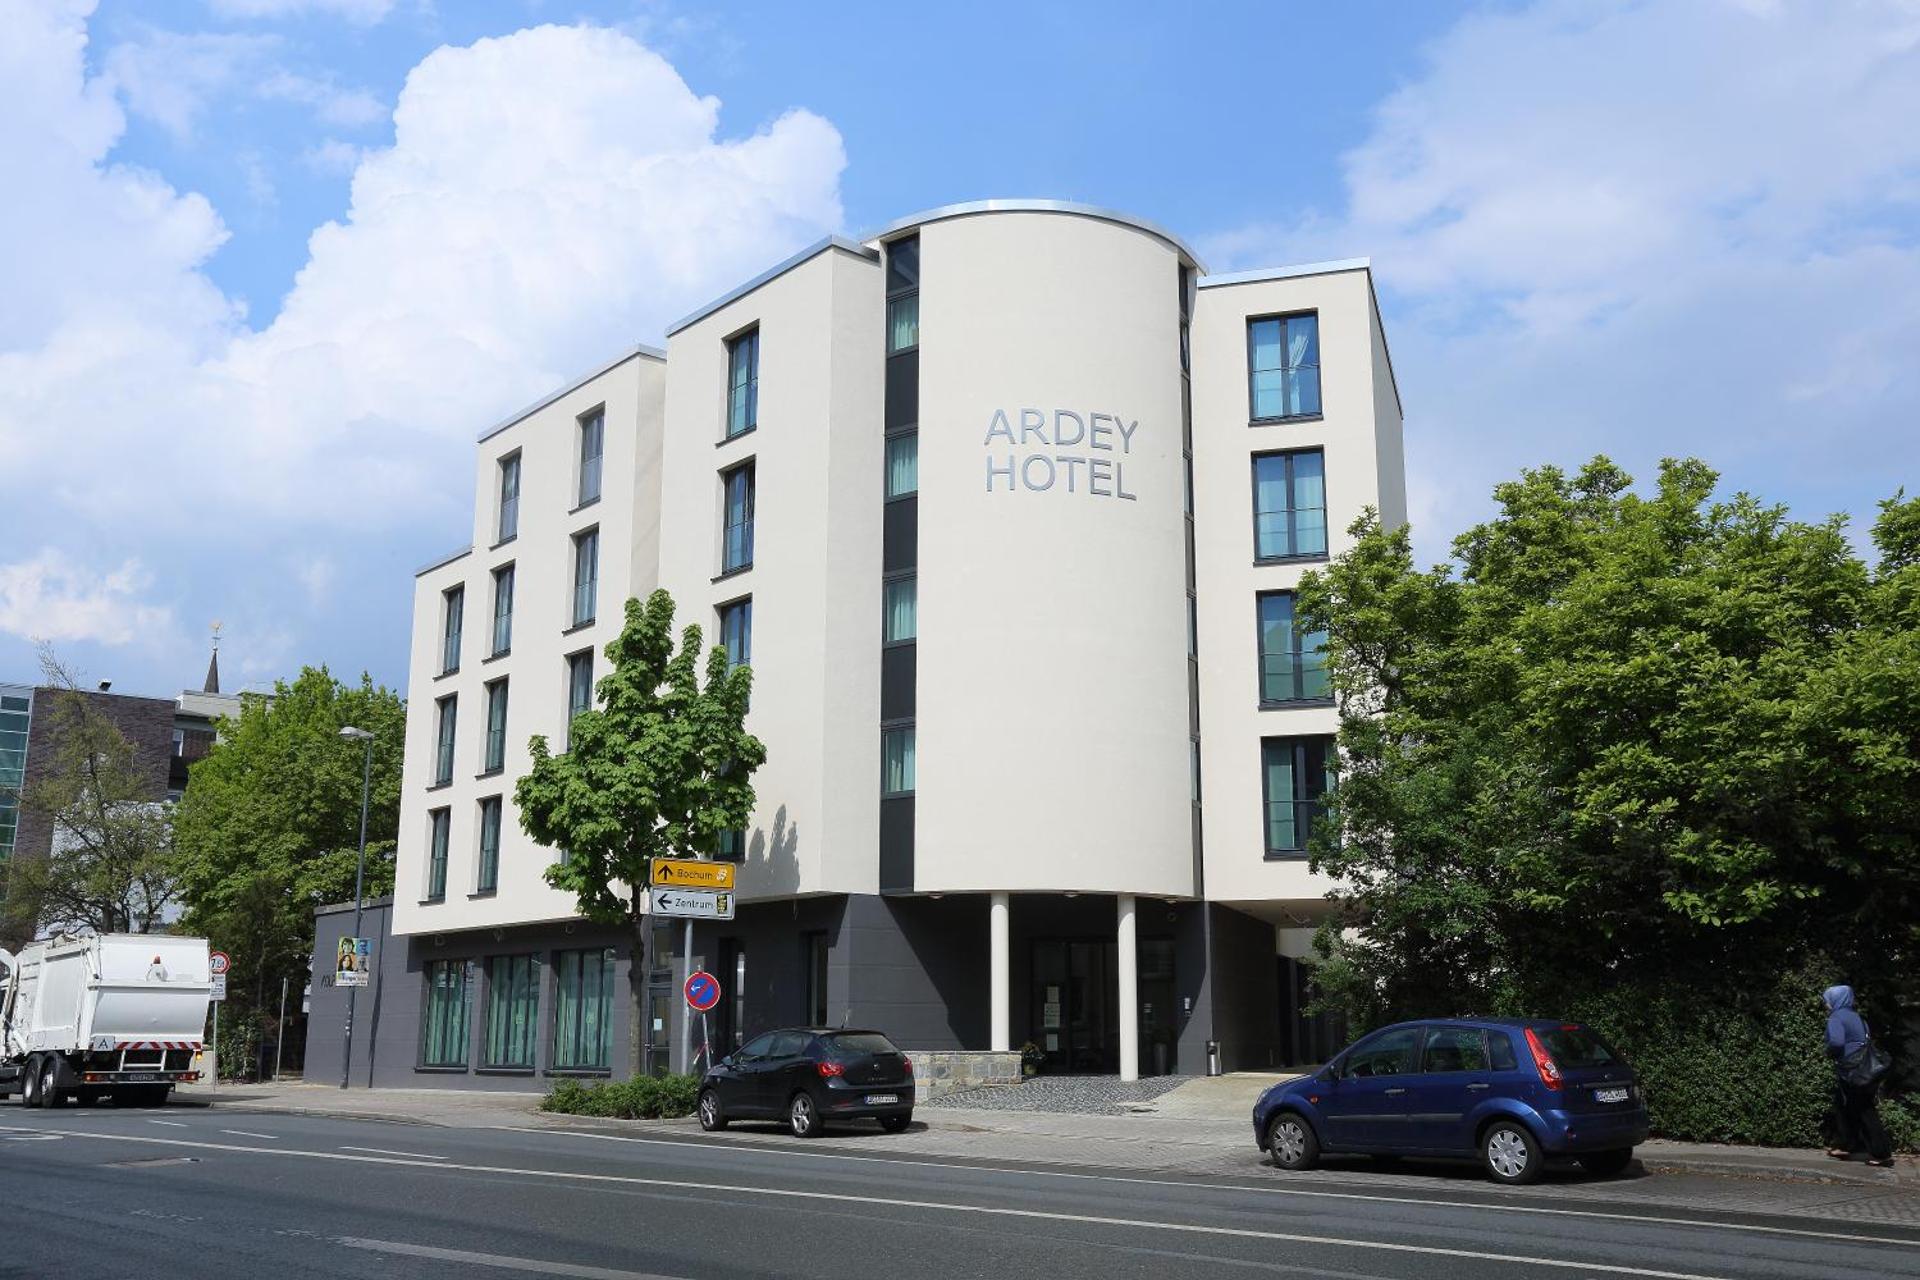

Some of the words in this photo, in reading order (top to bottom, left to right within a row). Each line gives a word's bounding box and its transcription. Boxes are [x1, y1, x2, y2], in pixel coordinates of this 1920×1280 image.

[984, 407, 1139, 453] ARDEY
[986, 453, 1137, 501] HOTEL
[677, 868, 713, 881] Bochum
[675, 898, 714, 909] Zentrum
[98, 1038, 108, 1048] A
